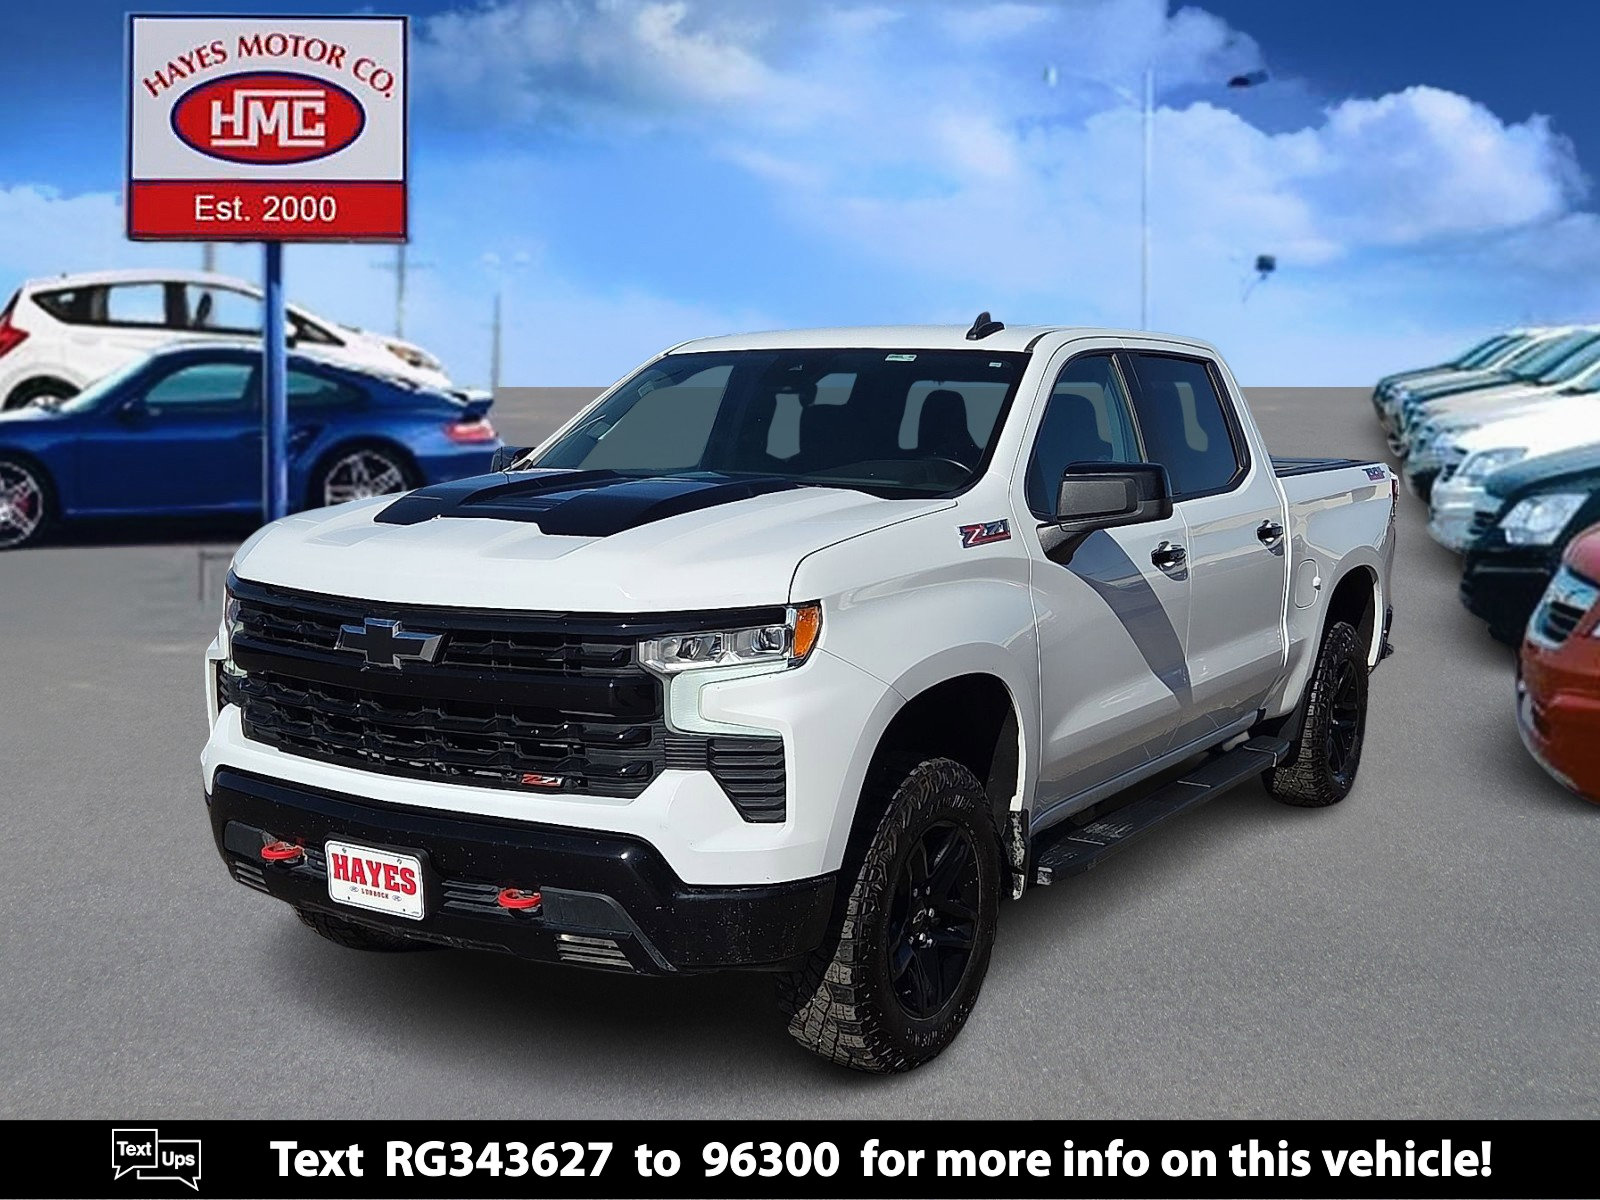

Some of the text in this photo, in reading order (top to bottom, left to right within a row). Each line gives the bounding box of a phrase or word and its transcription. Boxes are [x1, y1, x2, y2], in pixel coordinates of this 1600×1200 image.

[143, 33, 395, 98] HAYES MOTOR CO.
[210, 88, 326, 147] HMC
[195, 194, 337, 222] Est. 2000
[959, 519, 1011, 548] Z71
[332, 853, 417, 896] HAYES
